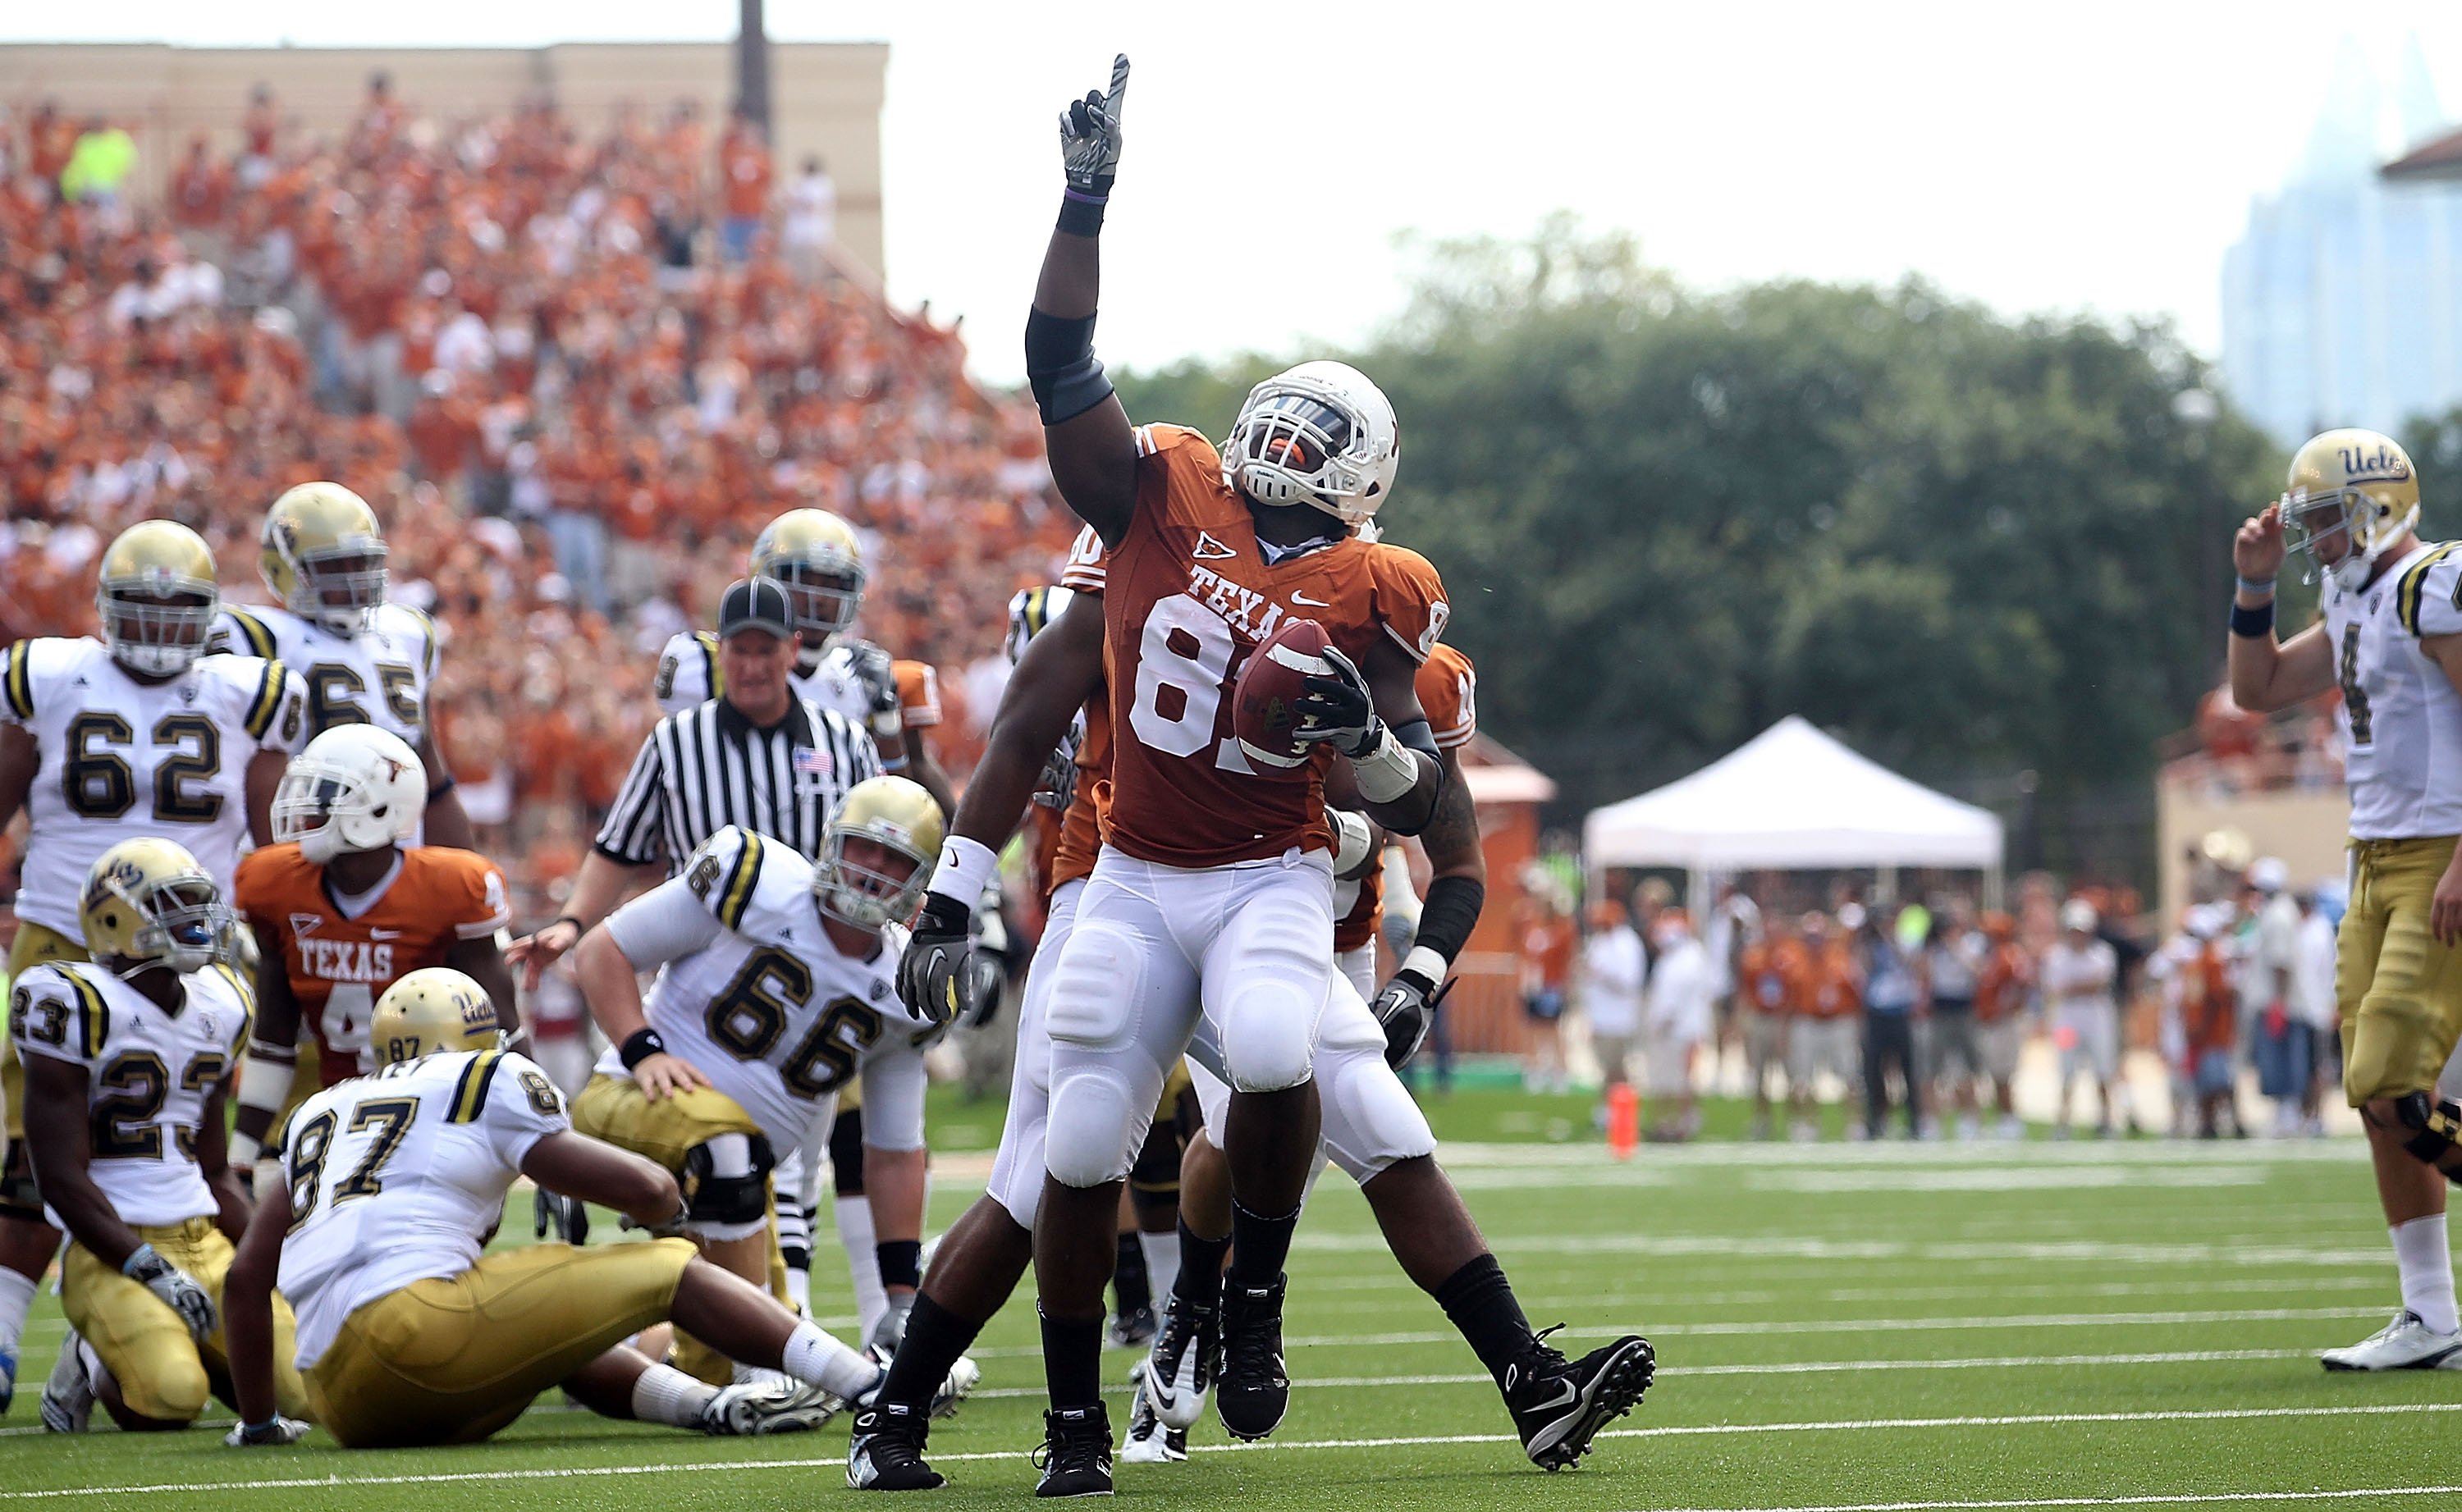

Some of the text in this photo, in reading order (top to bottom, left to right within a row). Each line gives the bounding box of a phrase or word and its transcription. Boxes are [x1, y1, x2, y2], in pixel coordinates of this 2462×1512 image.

[1188, 564, 1302, 642] TEXA
[304, 661, 423, 738] 65
[62, 710, 224, 823] 62
[296, 937, 394, 982] TEXAS
[320, 981, 378, 1076] 4
[389, 1035, 421, 1062] 87
[703, 943, 883, 1101] 66
[284, 1095, 422, 1239] 87
